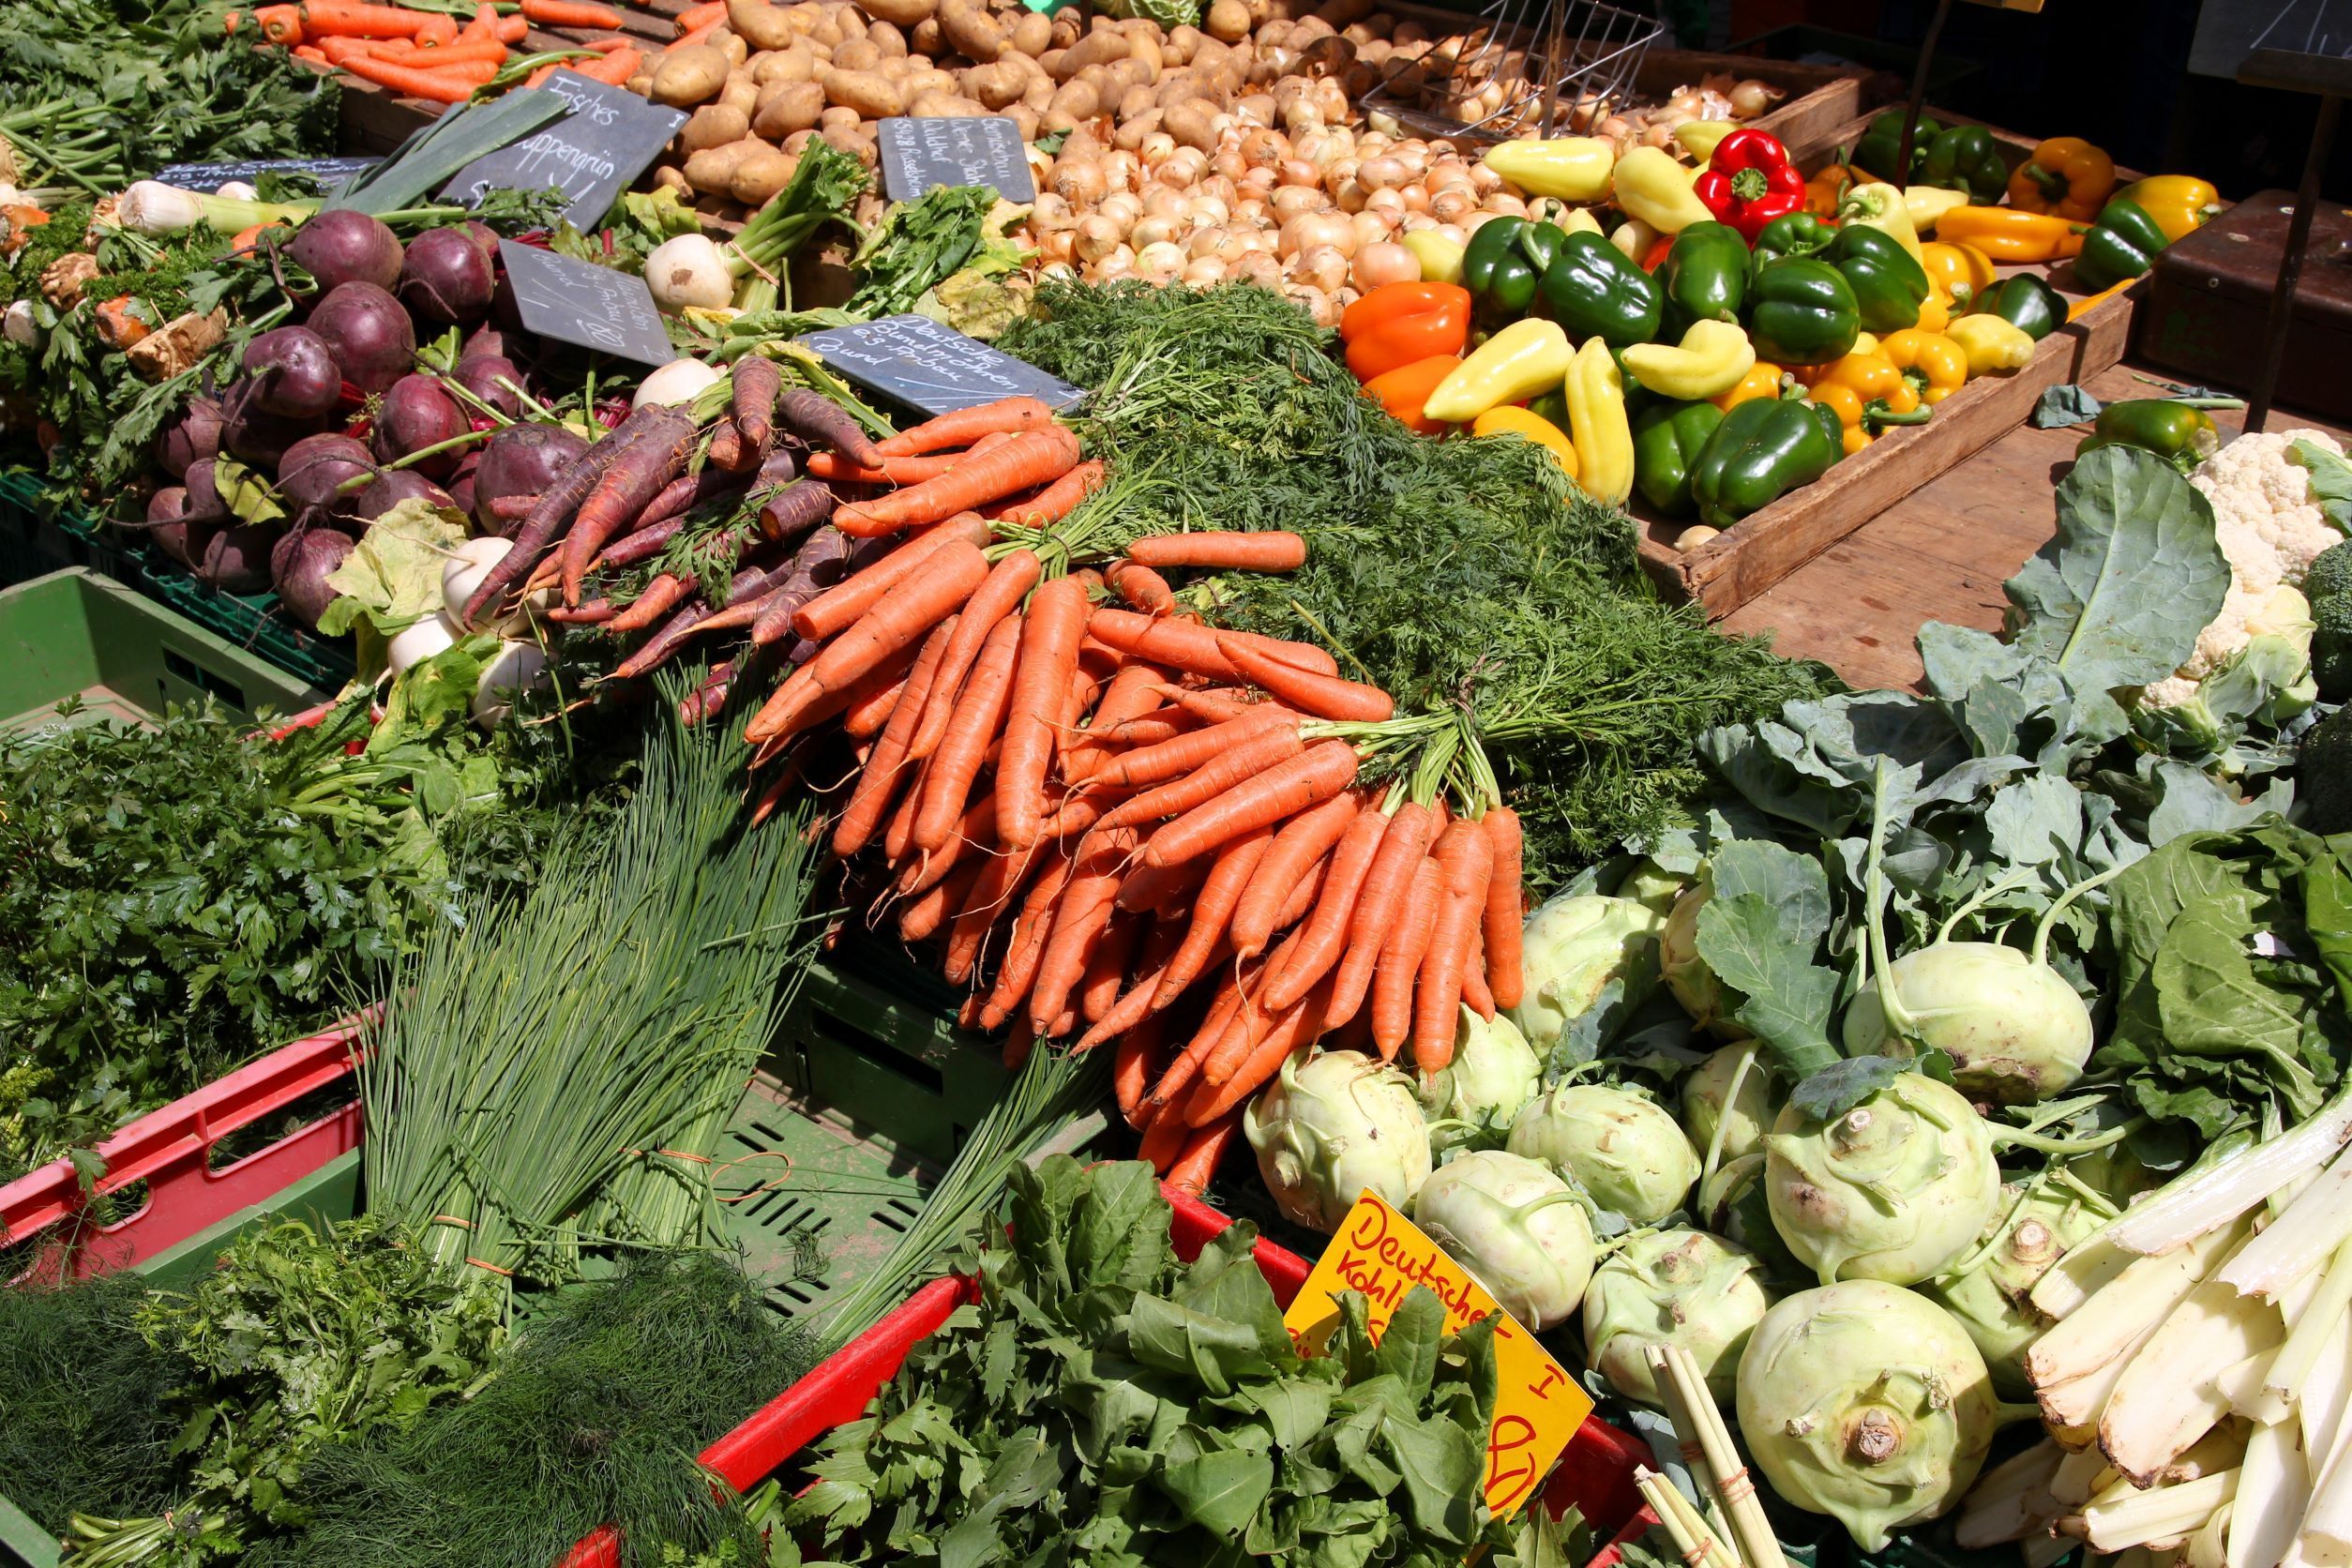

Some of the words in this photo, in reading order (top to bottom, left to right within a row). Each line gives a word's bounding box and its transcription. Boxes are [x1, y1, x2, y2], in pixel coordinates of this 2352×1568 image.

[517, 134, 615, 188] uppengrün
[813, 336, 892, 367] Bund
[874, 319, 1019, 390] Bundmöhren
[892, 315, 1004, 367] Deutsche
